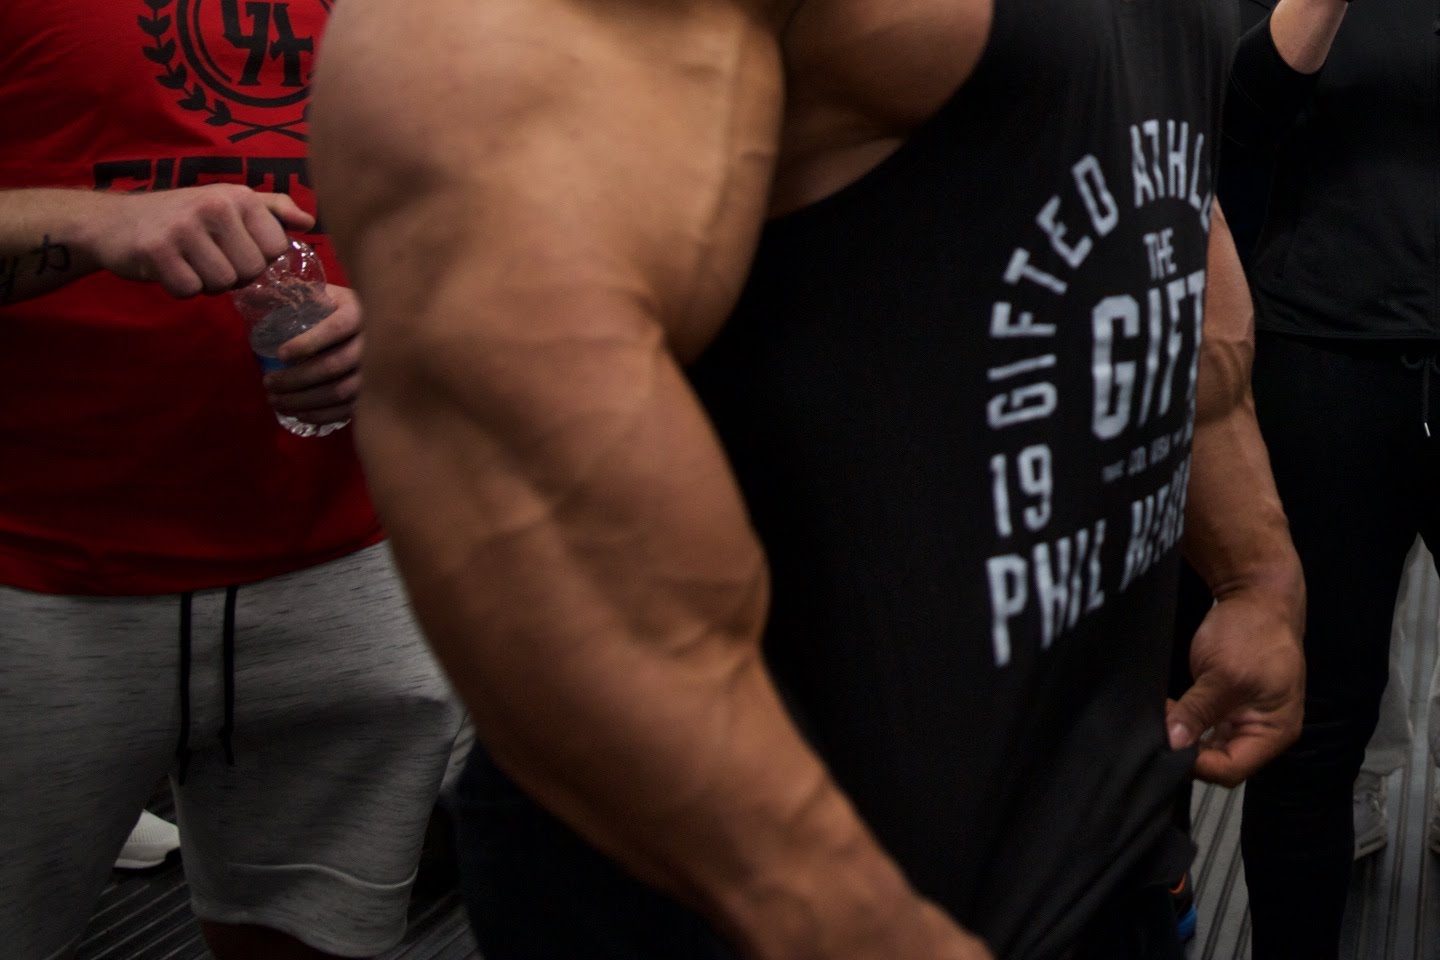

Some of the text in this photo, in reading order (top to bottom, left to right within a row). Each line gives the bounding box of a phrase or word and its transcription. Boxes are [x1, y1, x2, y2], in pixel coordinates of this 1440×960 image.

[987, 152, 1120, 429] GIFTED
[1143, 227, 1177, 280] THE
[1092, 269, 1208, 440] GIFT
[990, 444, 1052, 538] 19
[987, 518, 1107, 669] PHIL
